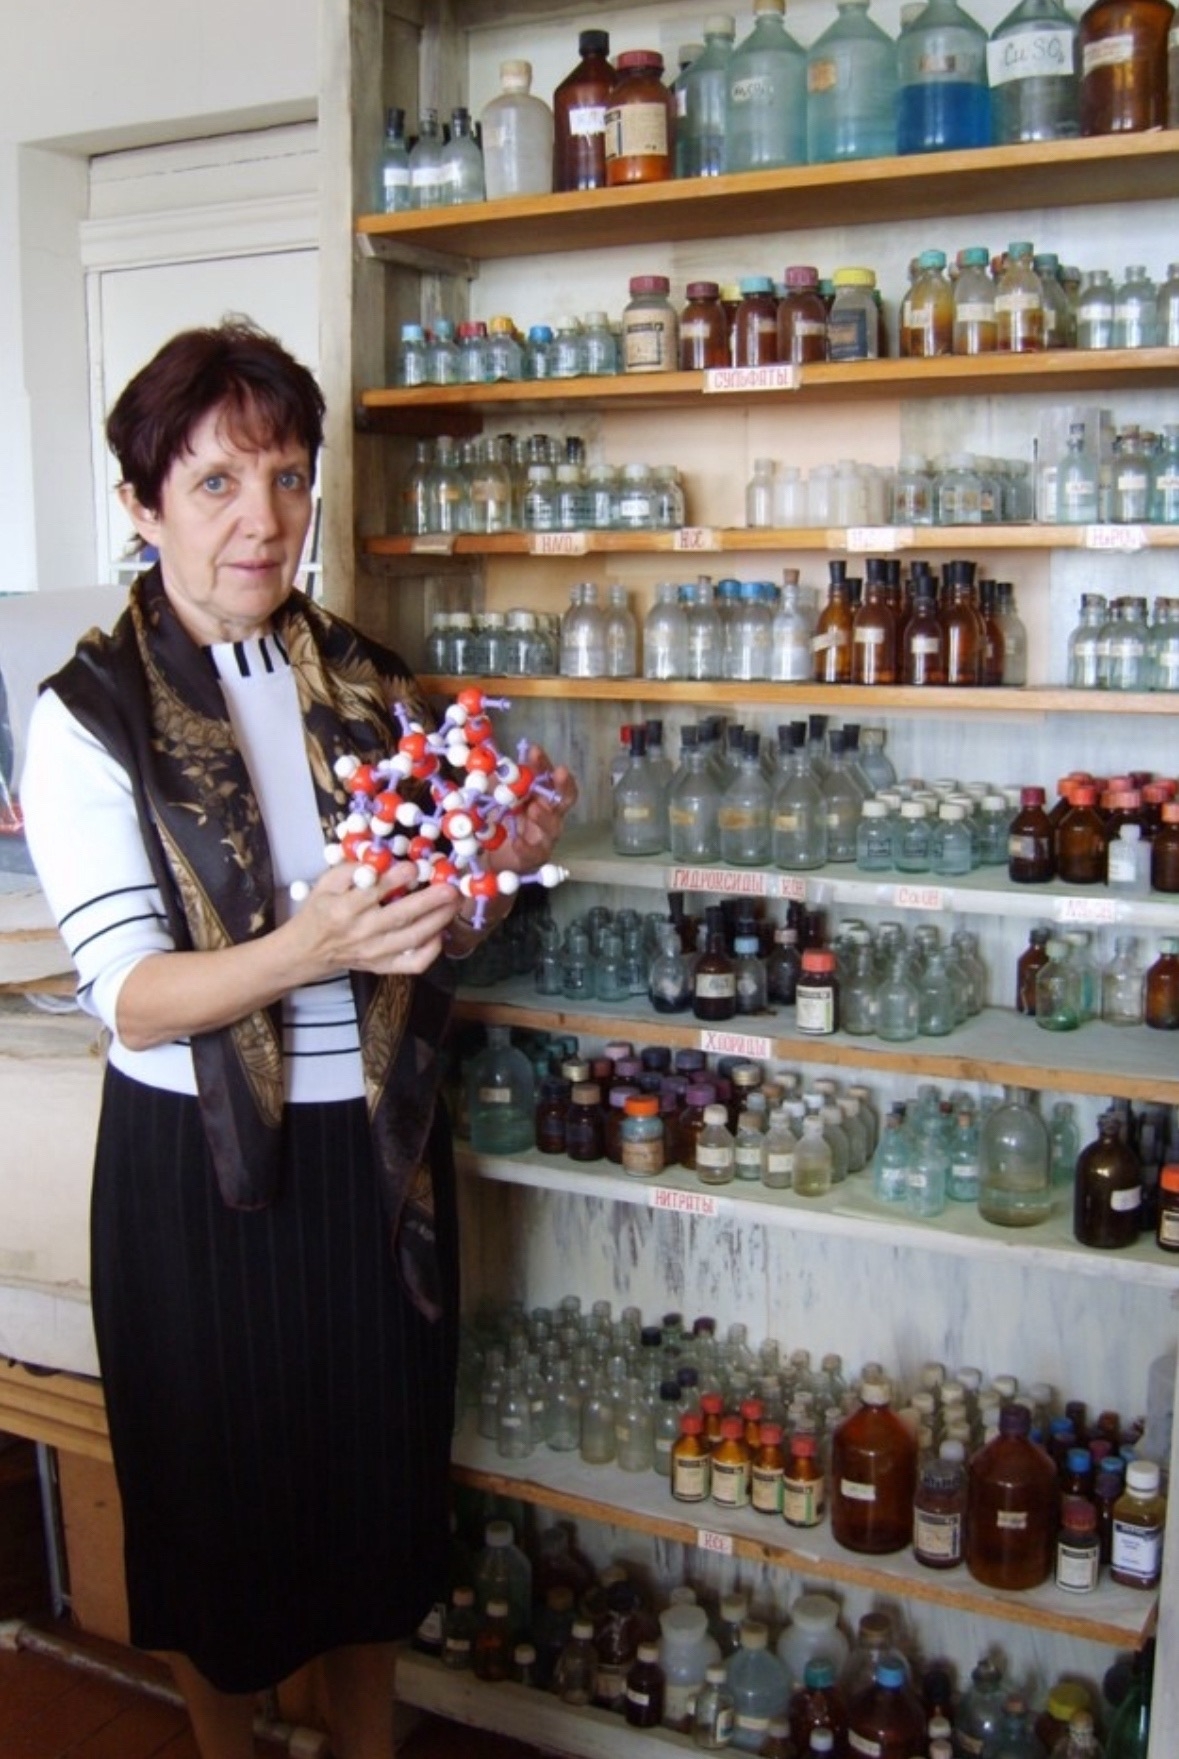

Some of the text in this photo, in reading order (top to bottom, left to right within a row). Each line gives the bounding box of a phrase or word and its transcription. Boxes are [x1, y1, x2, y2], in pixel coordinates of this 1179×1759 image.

[714, 368, 787, 388] СУЛЬФАТЫ
[673, 868, 763, 895] ГИДРОКСИДЫ
[655, 1188, 715, 1214] НИТРАТЫ
